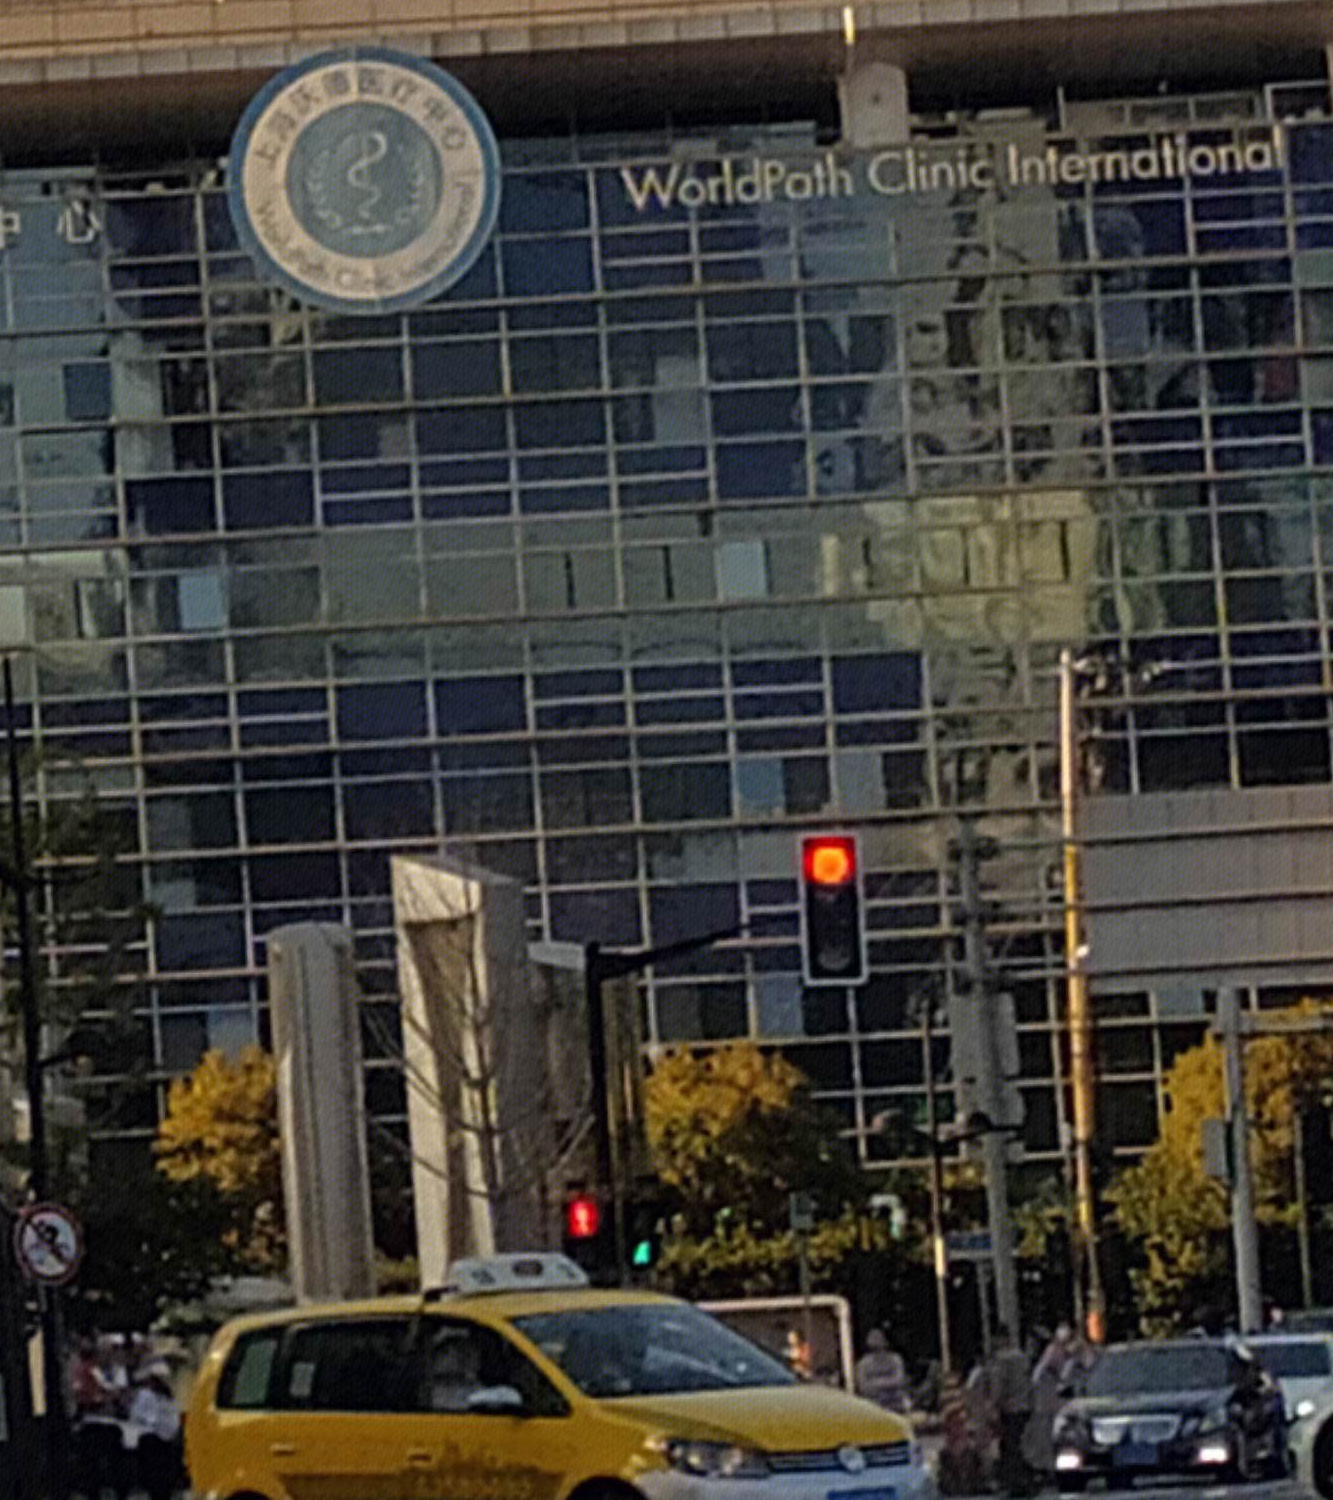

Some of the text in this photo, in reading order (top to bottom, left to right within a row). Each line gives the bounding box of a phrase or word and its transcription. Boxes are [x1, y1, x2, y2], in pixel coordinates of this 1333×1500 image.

[621, 125, 1285, 210] WorldPath Clinic International
